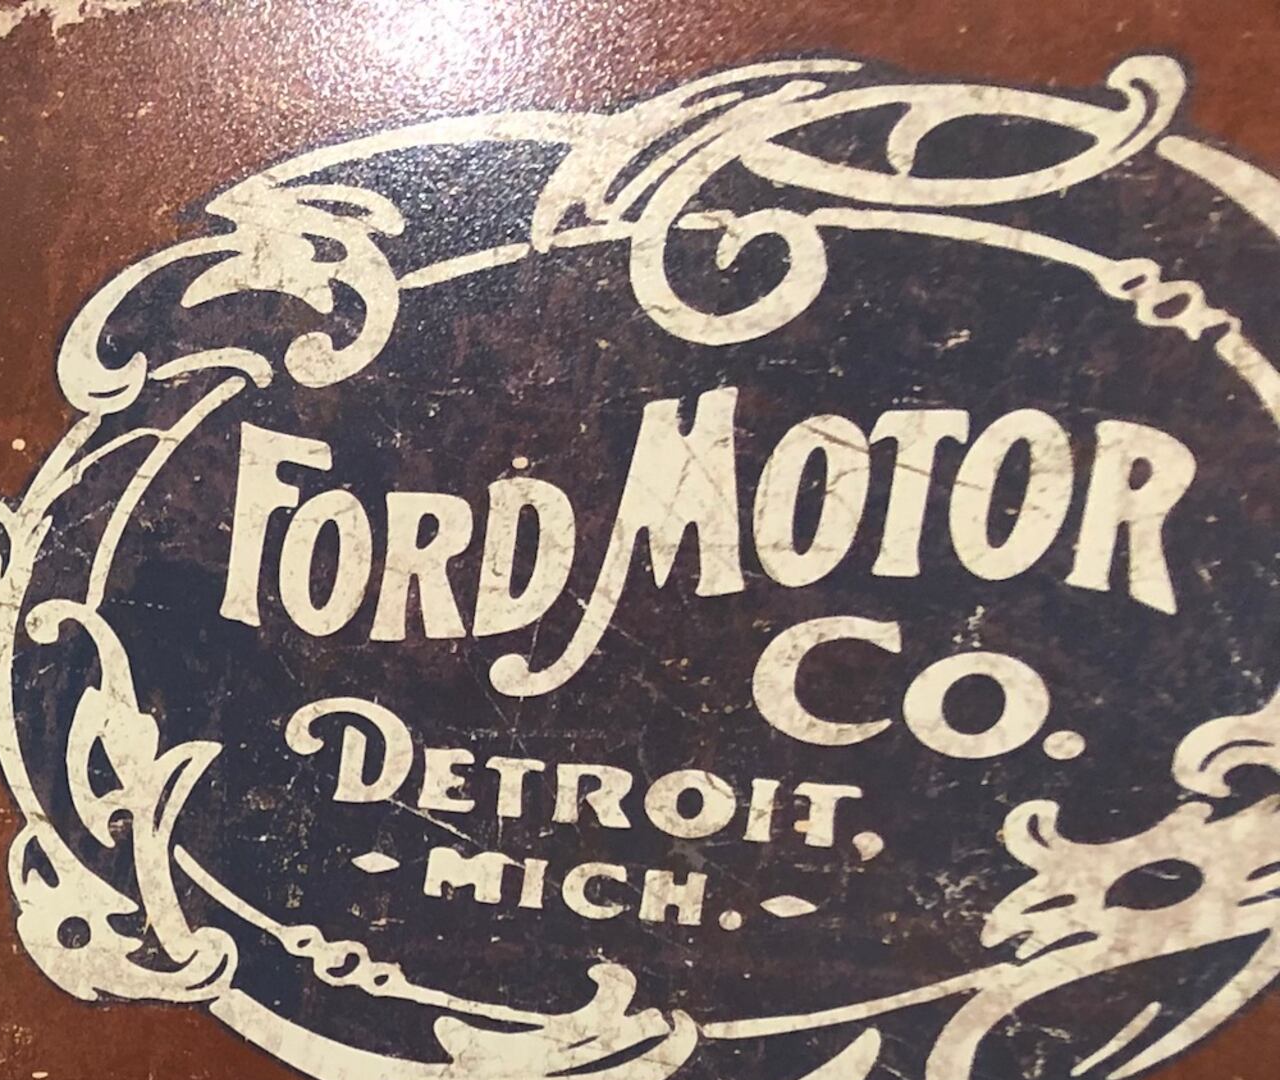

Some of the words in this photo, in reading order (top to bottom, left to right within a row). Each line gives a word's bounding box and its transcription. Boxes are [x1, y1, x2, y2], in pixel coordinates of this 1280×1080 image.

[220, 421, 576, 641] FORD
[490, 386, 1198, 696] MOTOR
[752, 614, 1086, 761] CO.
[285, 695, 884, 861] DETROIT,
